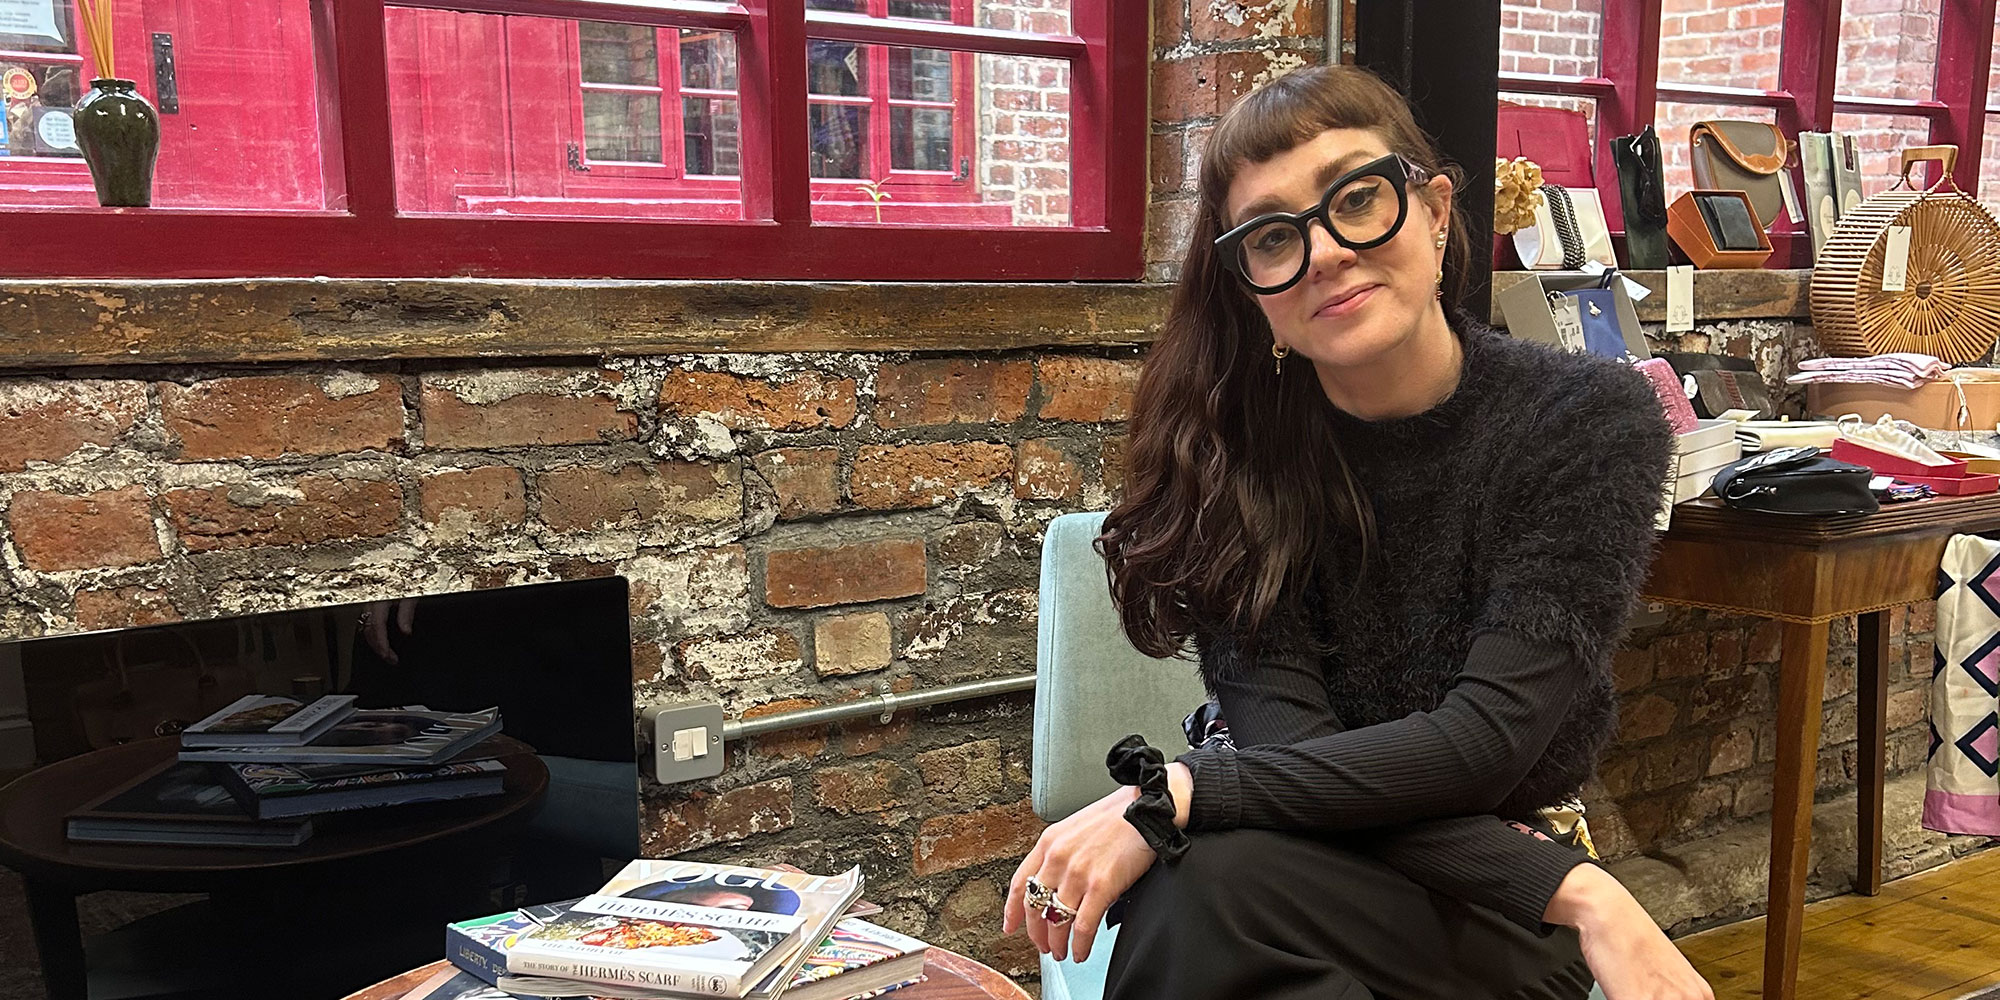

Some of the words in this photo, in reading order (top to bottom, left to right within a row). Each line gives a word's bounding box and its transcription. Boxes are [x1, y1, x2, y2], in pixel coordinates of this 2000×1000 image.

[523, 961, 536, 969] THE
[538, 963, 558, 971] STORY
[580, 965, 635, 983] HERMÈS
[638, 971, 681, 986] SCARF
